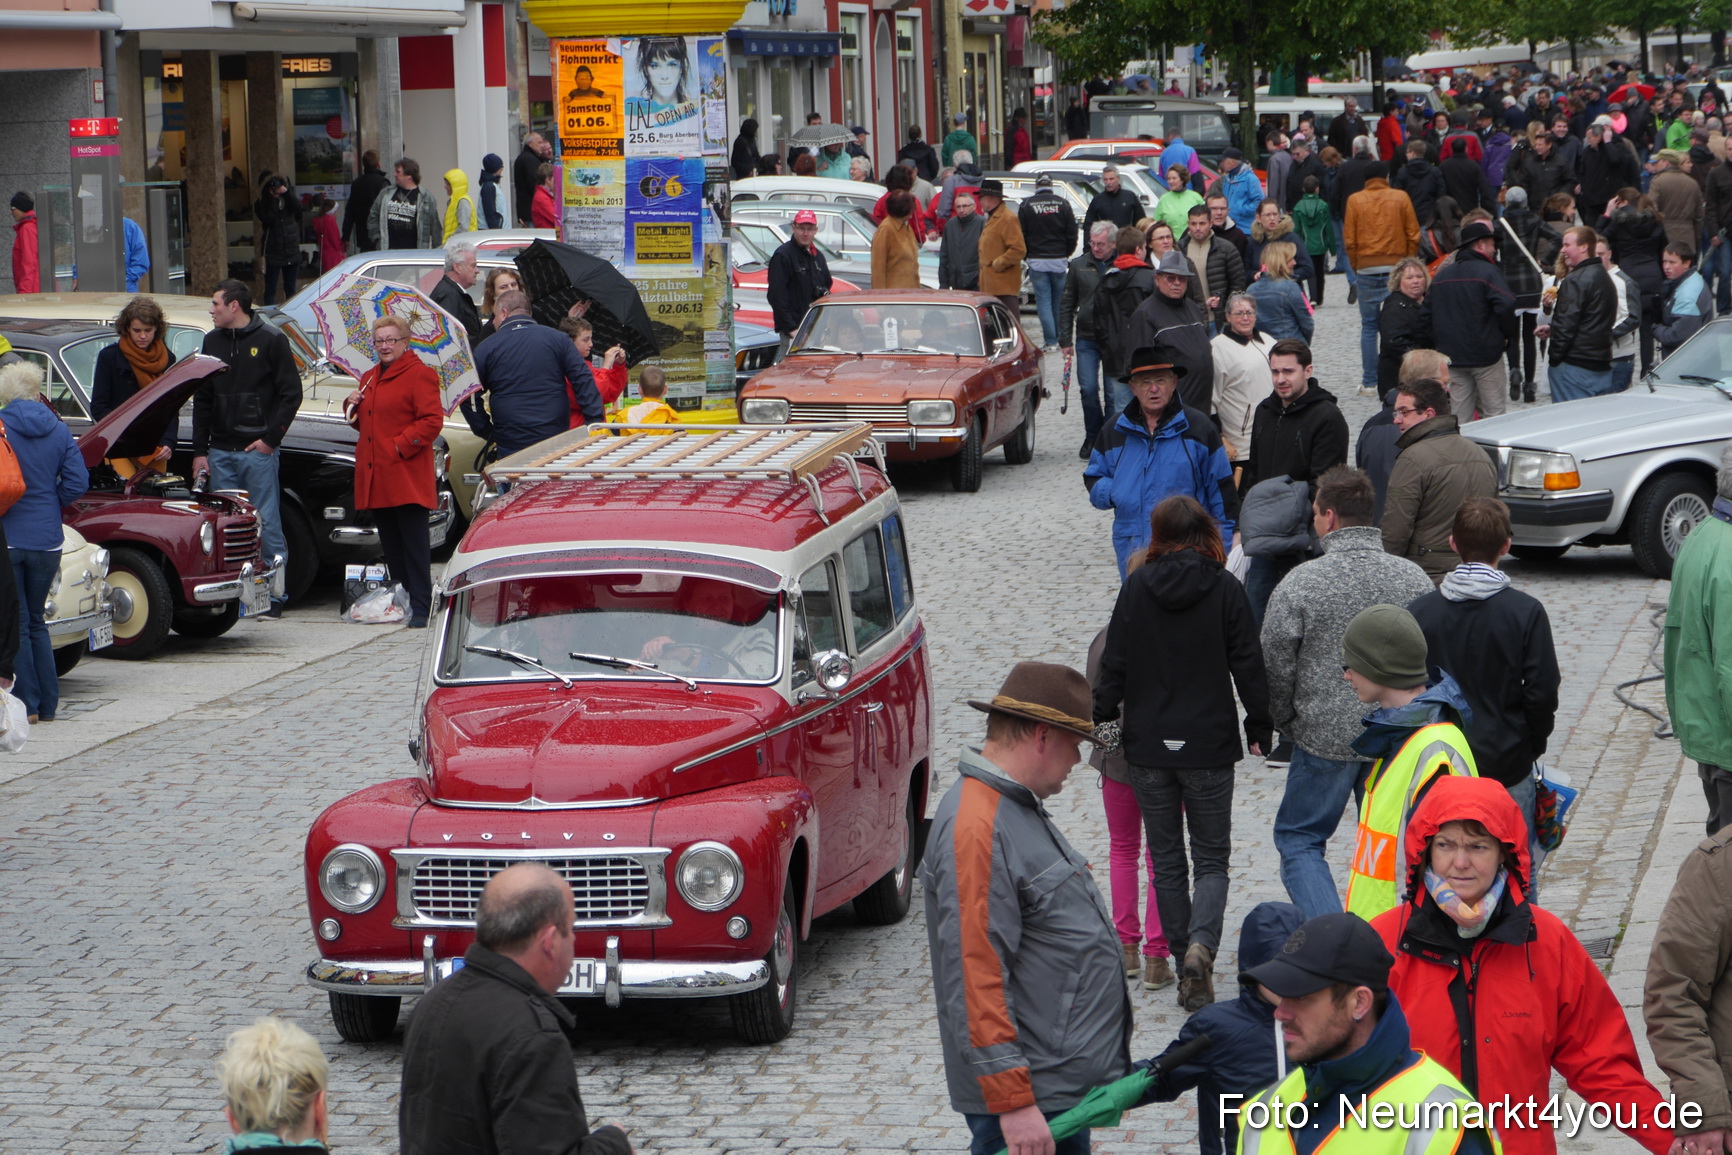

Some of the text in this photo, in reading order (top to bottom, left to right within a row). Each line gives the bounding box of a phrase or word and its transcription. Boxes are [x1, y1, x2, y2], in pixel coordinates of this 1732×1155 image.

[560, 44, 607, 54] Neumarkt
[560, 55, 619, 65] Flohmarkt
[566, 104, 612, 114] Samstag
[627, 99, 654, 131] ZAZ
[656, 108, 682, 126] OPEN
[683, 103, 698, 119] AIR
[568, 117, 610, 128] 01.06.
[629, 133, 659, 143] 25.6.
[563, 139, 619, 148] Volksfestplatz
[77, 146, 102, 154] HotSpot
[1032, 204, 1060, 214] West
[639, 227, 689, 235] Metal Night
[653, 280, 688, 291] Jahre
[640, 291, 703, 303] ulztalbahn
[658, 303, 703, 314] 02.06.13
[442, 832, 616, 841] VOLVO
